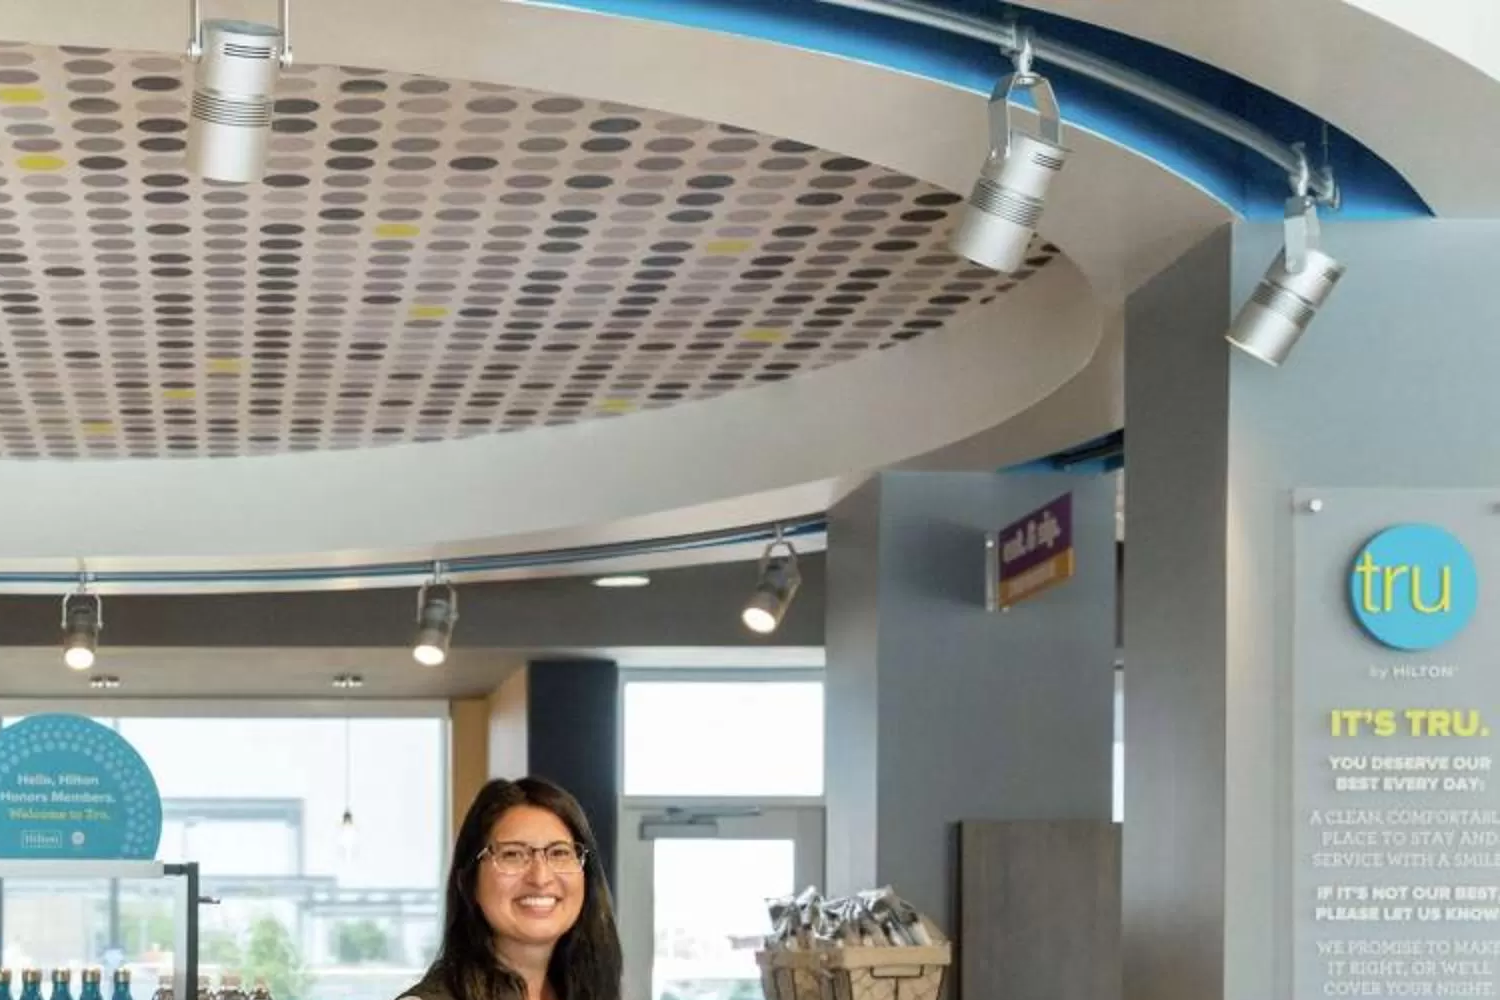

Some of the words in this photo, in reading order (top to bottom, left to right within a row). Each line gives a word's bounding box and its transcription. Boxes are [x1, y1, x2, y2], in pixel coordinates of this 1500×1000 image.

[1355, 551, 1451, 614] tru
[1369, 665, 1387, 679] by
[1392, 665, 1454, 678] HILTON
[1330, 709, 1397, 737] IT'S
[1405, 709, 1490, 737] TRU.
[1329, 756, 1368, 771] YOU
[1371, 756, 1449, 771] DESERVE
[1453, 756, 1492, 771] OUR
[16, 773, 56, 787] Hello,
[58, 773, 100, 786] Hilton
[1335, 777, 1380, 791] BEST
[1383, 777, 1438, 791] EVERY
[0, 790, 48, 803] Honors
[1309, 809, 1322, 825] A
[1386, 810, 1500, 825] COMFORTABL
[1322, 831, 1377, 846] PLACE
[1381, 831, 1407, 846] TO
[1411, 831, 1456, 846] STAY
[1460, 831, 1498, 846] AND
[1312, 852, 1384, 868] SERVICE
[1386, 852, 1433, 867] WITH
[1437, 852, 1451, 867] A
[1317, 886, 1333, 900] IF
[1337, 886, 1369, 900] IT'S
[1372, 886, 1409, 900] NOT
[1412, 886, 1451, 900] OUR
[1315, 907, 1380, 921] PLEASE
[1383, 907, 1412, 921] LET
[1417, 907, 1441, 921] US
[1316, 940, 1345, 955] WE
[1348, 940, 1423, 955] PROMISE
[1426, 940, 1450, 955] TO
[1327, 961, 1346, 975] IT
[1411, 961, 1437, 975] OR
[1323, 981, 1381, 996] COVER
[1385, 981, 1433, 996] YOUR
